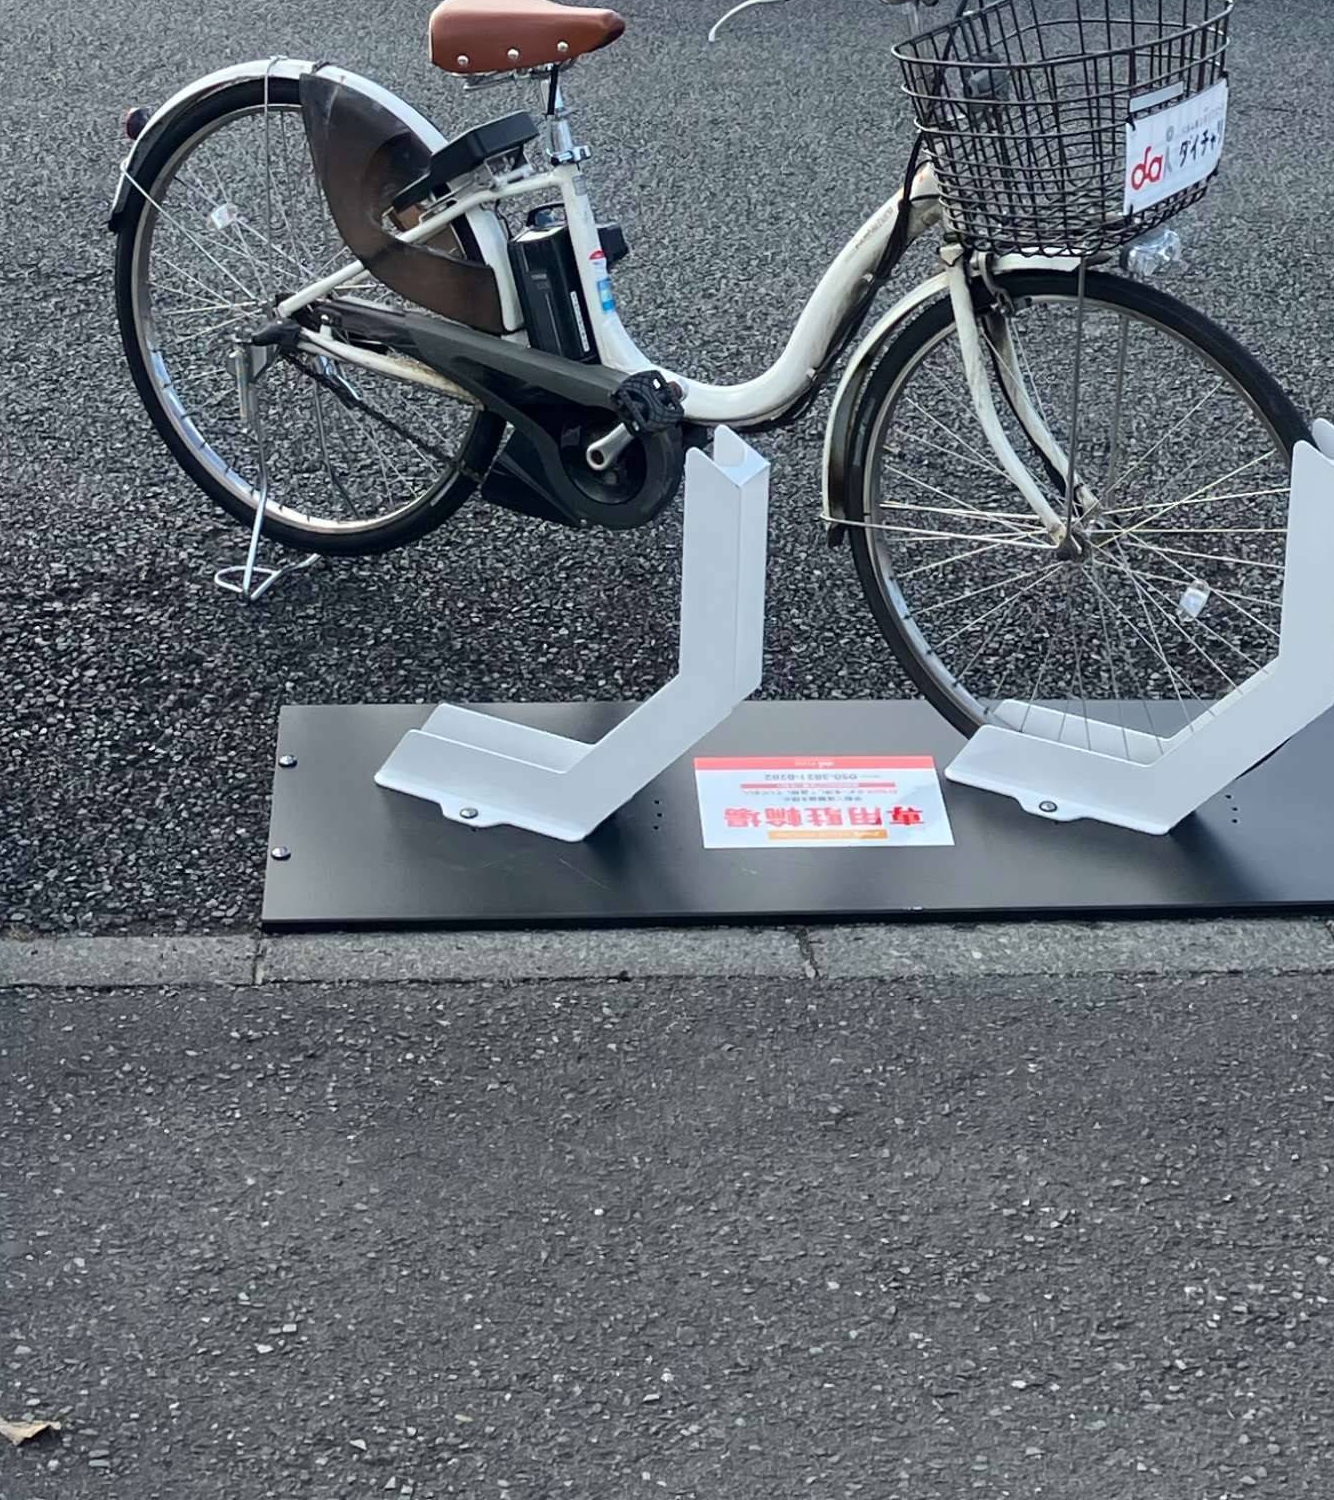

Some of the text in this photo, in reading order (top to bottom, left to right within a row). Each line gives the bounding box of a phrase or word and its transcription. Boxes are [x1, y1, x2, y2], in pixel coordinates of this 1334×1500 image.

[723, 805, 925, 828] 専用駐輪場
